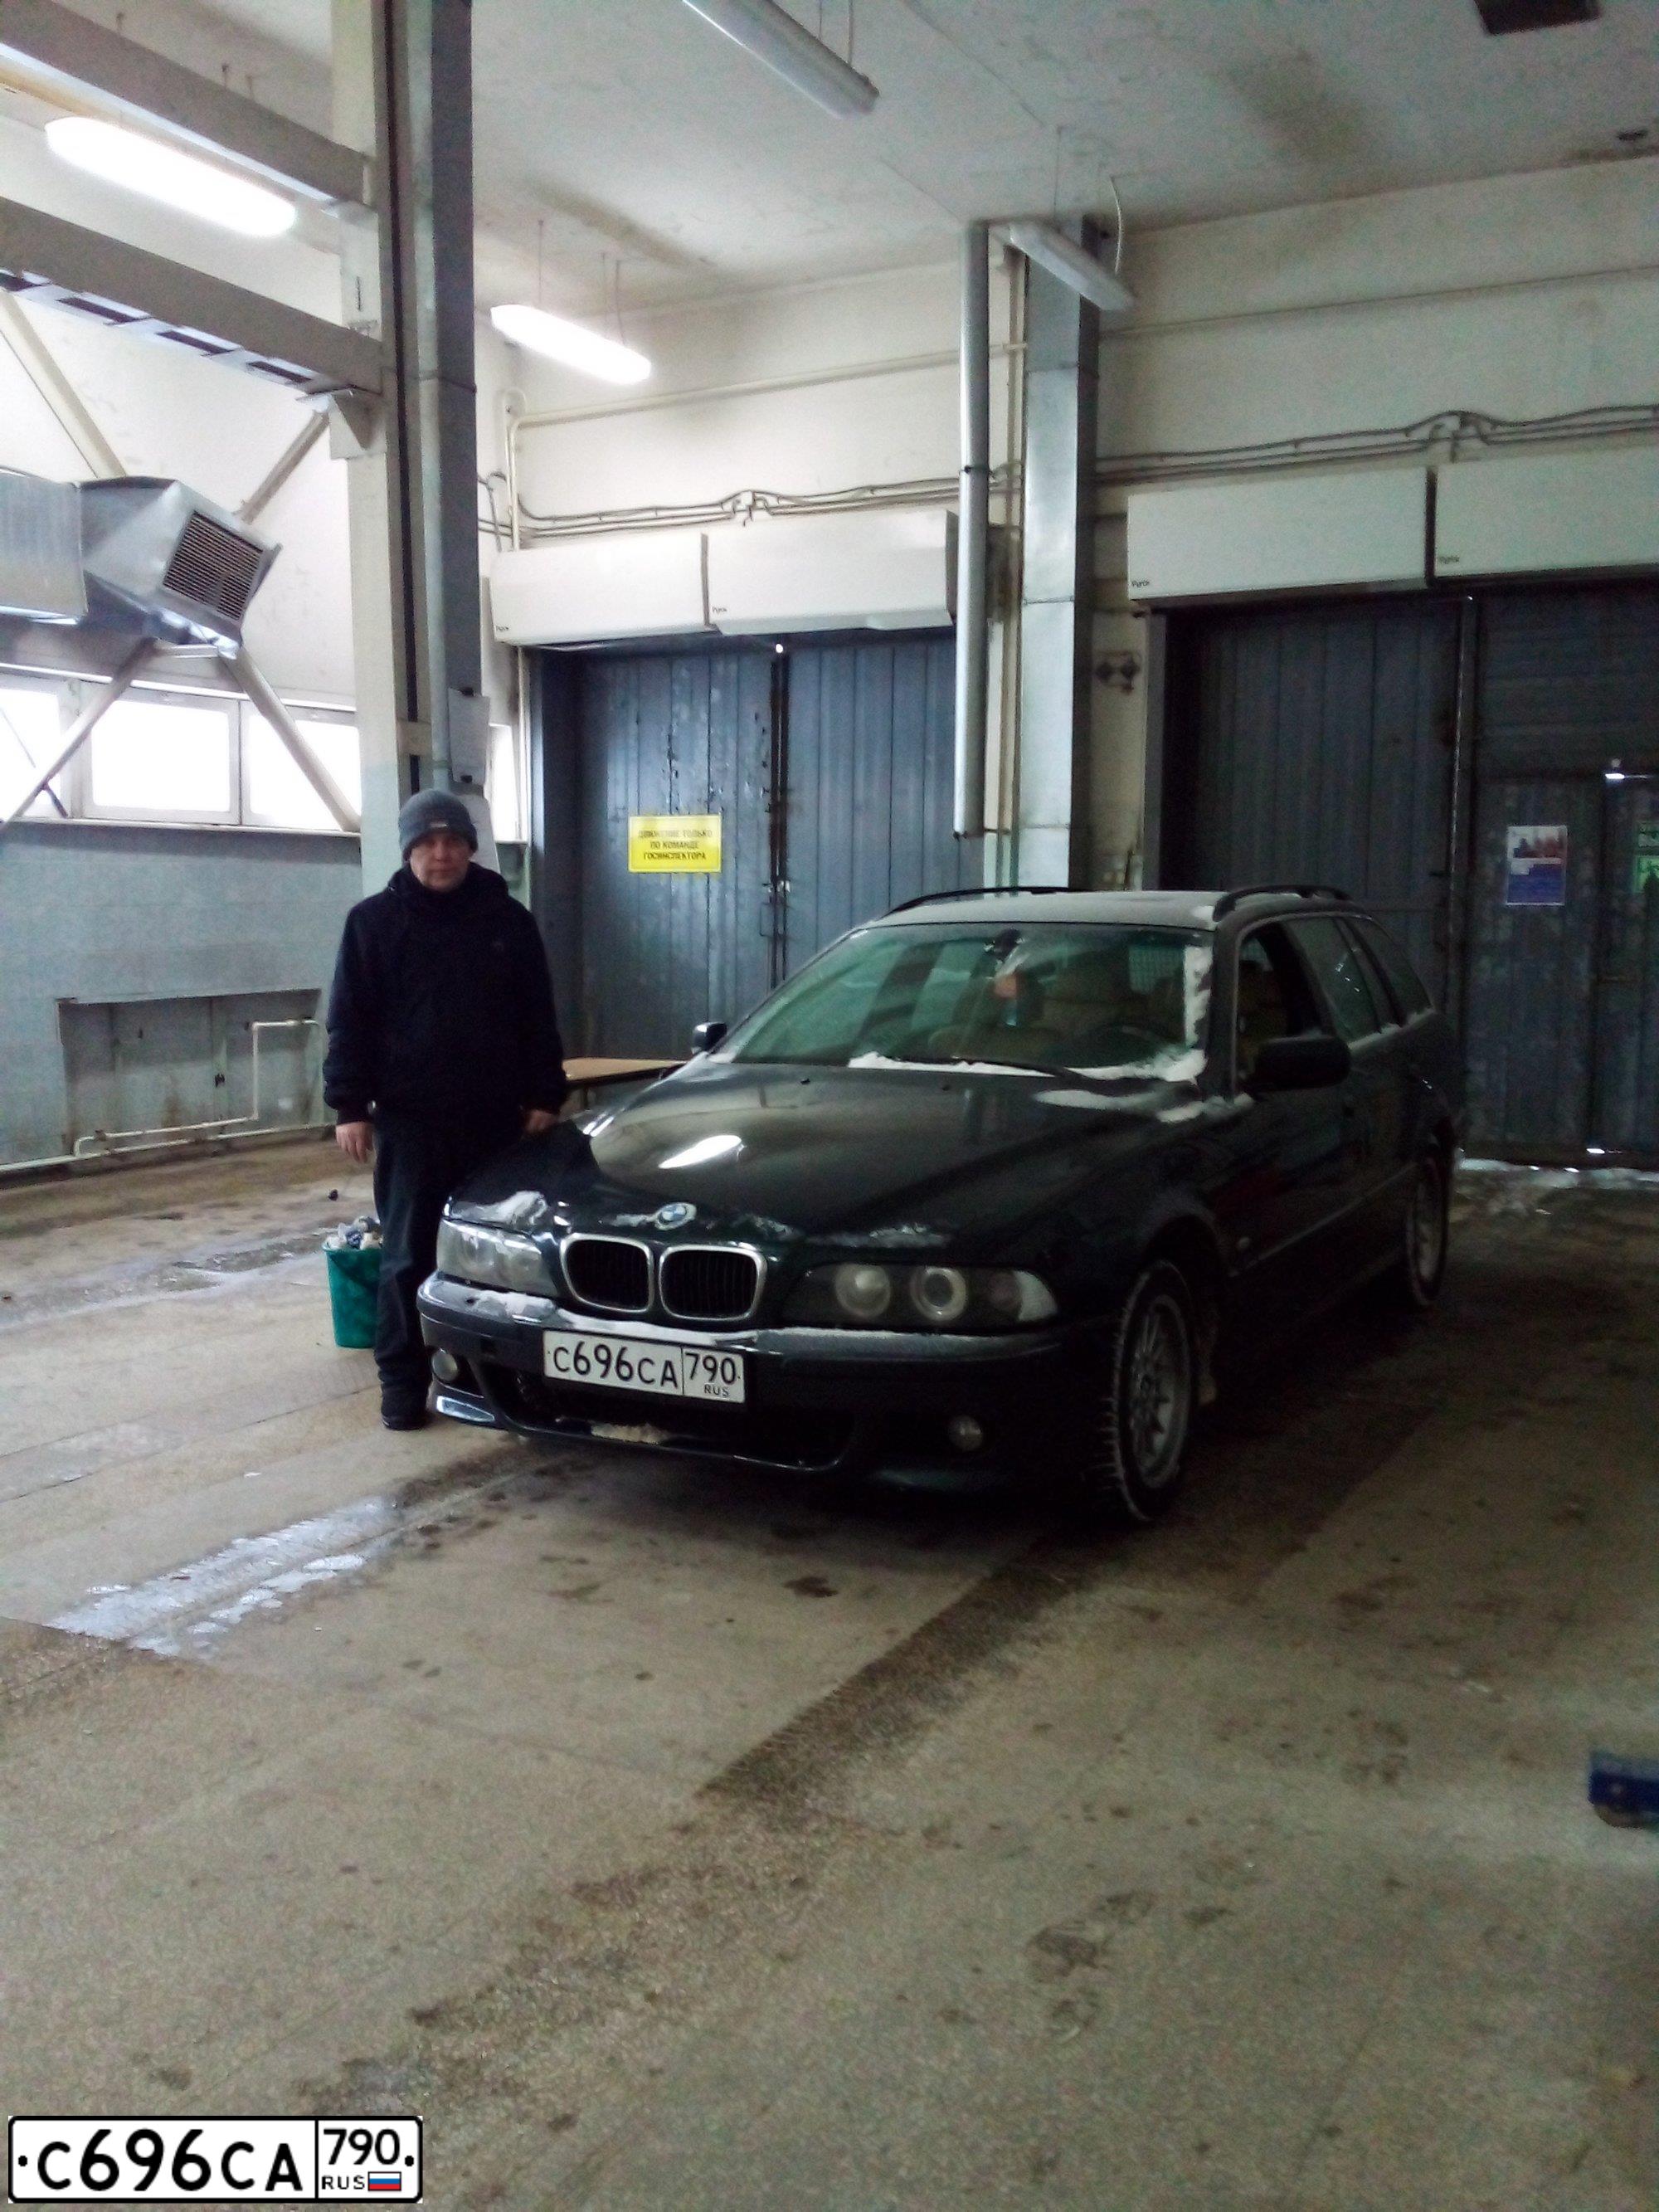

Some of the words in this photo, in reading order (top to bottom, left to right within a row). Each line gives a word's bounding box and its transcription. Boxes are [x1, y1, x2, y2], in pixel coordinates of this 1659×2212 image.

[650, 840, 660, 849] ПО
[685, 1352, 737, 1385] 790
[704, 1385, 729, 1397] RUS
